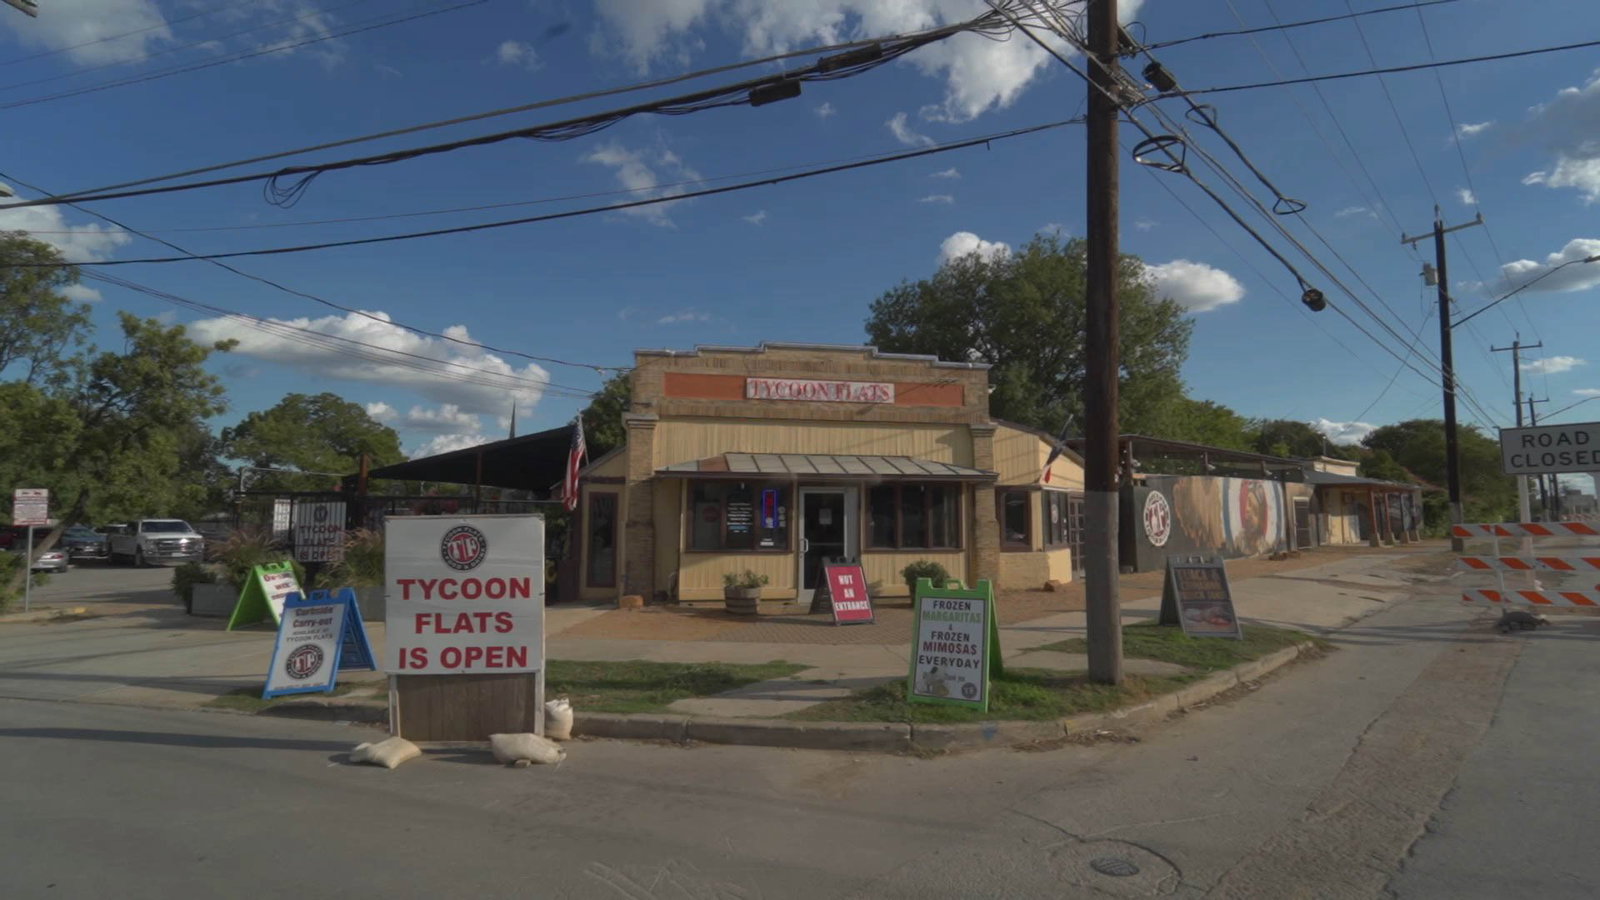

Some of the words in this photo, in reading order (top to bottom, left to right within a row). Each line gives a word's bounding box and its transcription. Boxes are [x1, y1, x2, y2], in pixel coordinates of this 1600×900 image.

[750, 380, 829, 399] TYCOON
[835, 382, 890, 401] FLATS
[1521, 431, 1590, 448] ROAD
[1510, 449, 1600, 468] CLOSED
[838, 574, 853, 585] NOT
[396, 577, 531, 600] TYCOON
[844, 588, 855, 598] AN
[835, 601, 870, 611] ENTRANCE
[933, 600, 971, 611] FROZEN
[293, 617, 333, 628] Carry-out
[415, 611, 514, 634] FLATS
[922, 611, 982, 623] MARGARITAS
[930, 631, 970, 642] FROZEN
[922, 641, 978, 655] MIMOSAS
[398, 647, 428, 669] IS
[440, 646, 528, 669] OPEN
[918, 655, 980, 669] EVERYDAY
